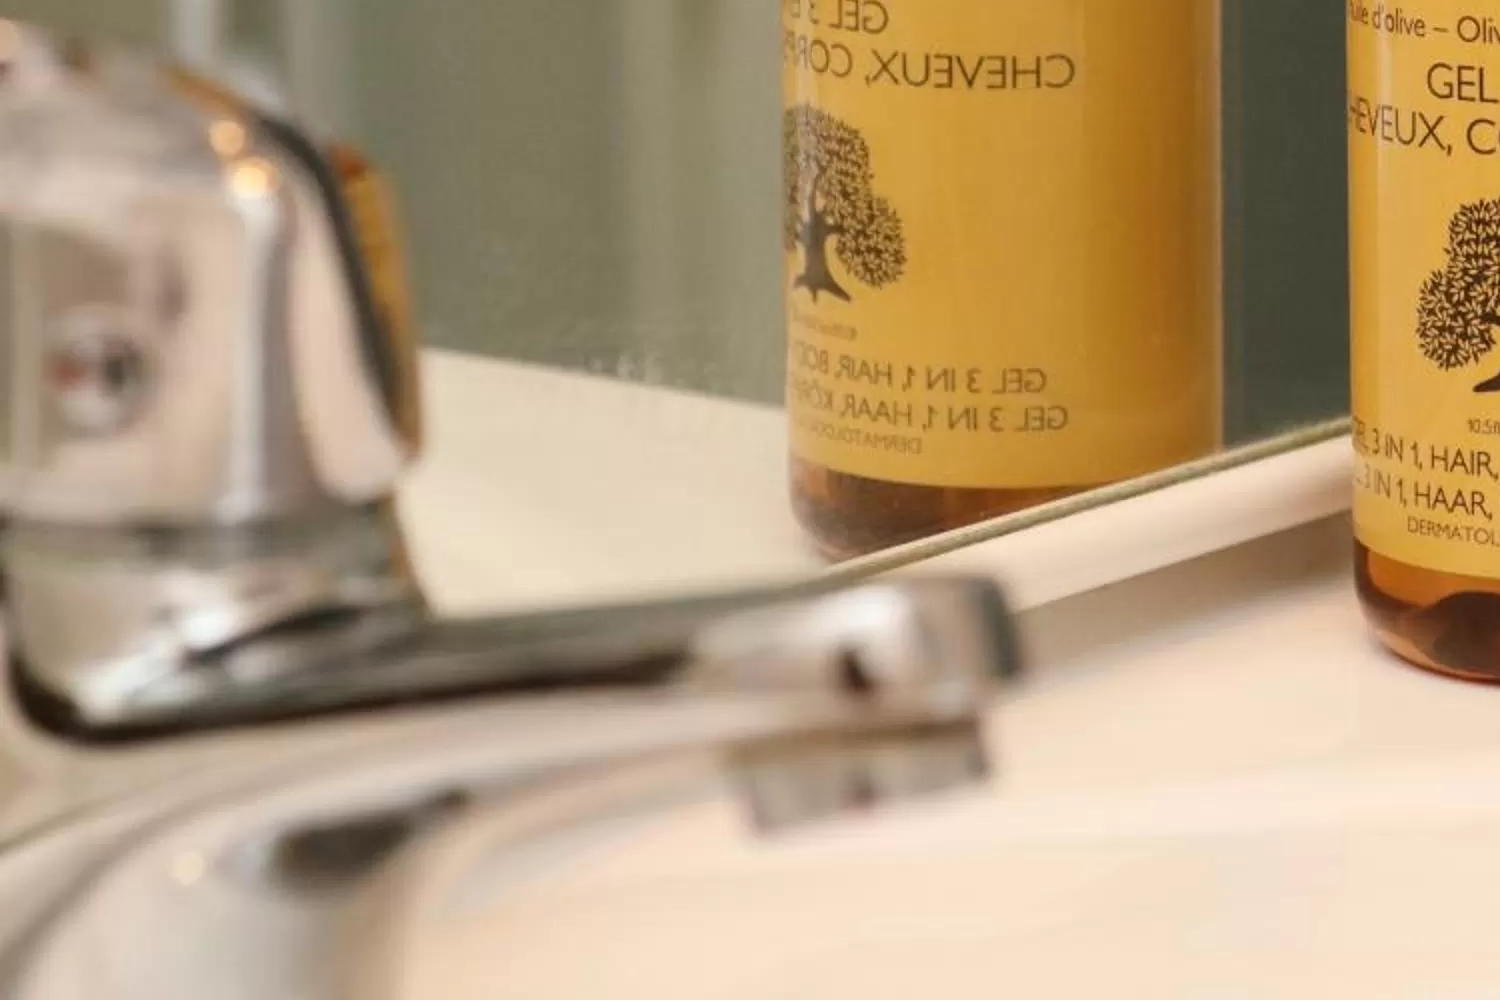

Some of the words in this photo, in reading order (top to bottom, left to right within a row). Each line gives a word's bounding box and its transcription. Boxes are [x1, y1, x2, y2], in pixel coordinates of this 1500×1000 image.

[1372, 3, 1426, 37] d'olive
[1426, 62, 1500, 104] GEL
[1384, 432, 1404, 464] IN
[1431, 444, 1499, 482] HAIR,
[1414, 480, 1493, 521] HAAR,
